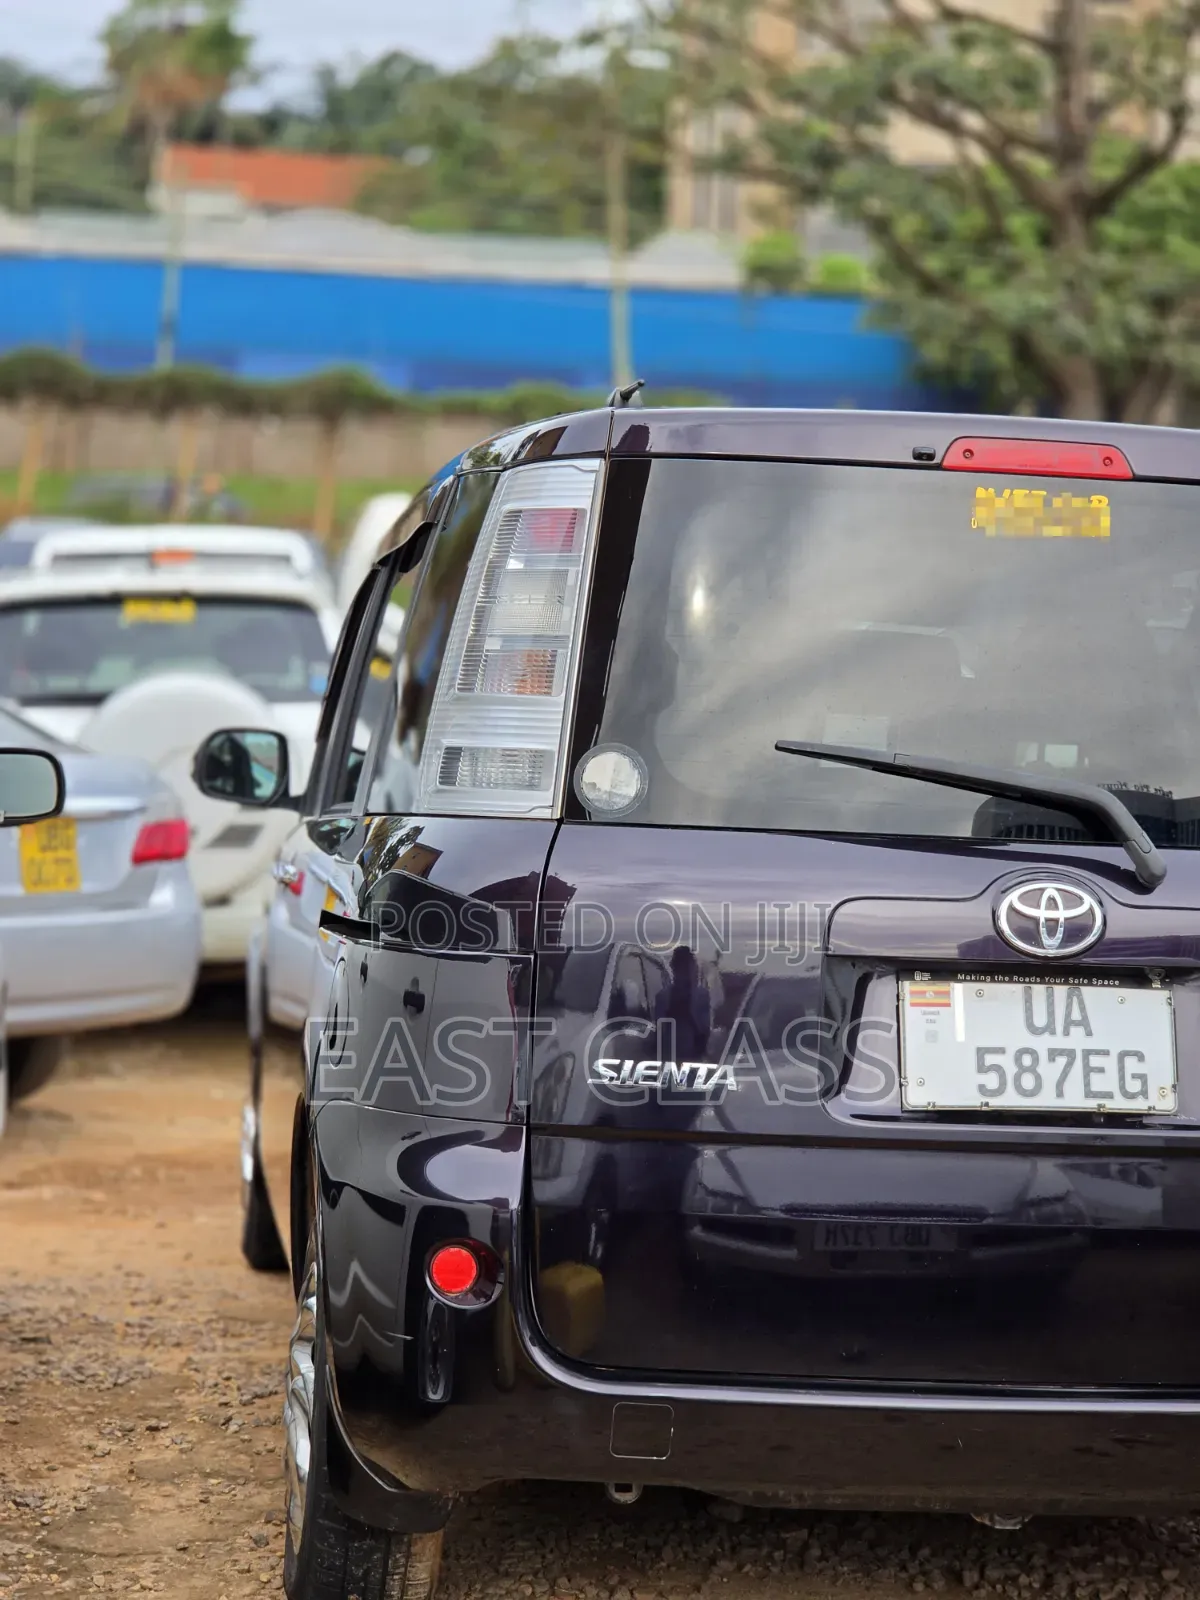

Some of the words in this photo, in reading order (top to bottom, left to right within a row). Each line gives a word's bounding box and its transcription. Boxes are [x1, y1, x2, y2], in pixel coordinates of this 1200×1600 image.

[957, 973, 991, 983] Making
[994, 974, 1009, 982] the
[1013, 975, 1041, 983] Roads
[1044, 976, 1065, 984] Your
[1068, 977, 1088, 985] Safe
[1092, 977, 1120, 987] Space
[1023, 985, 1093, 1037] UA
[588, 1058, 738, 1091] SIENTA
[976, 1046, 1149, 1100] 587EG
